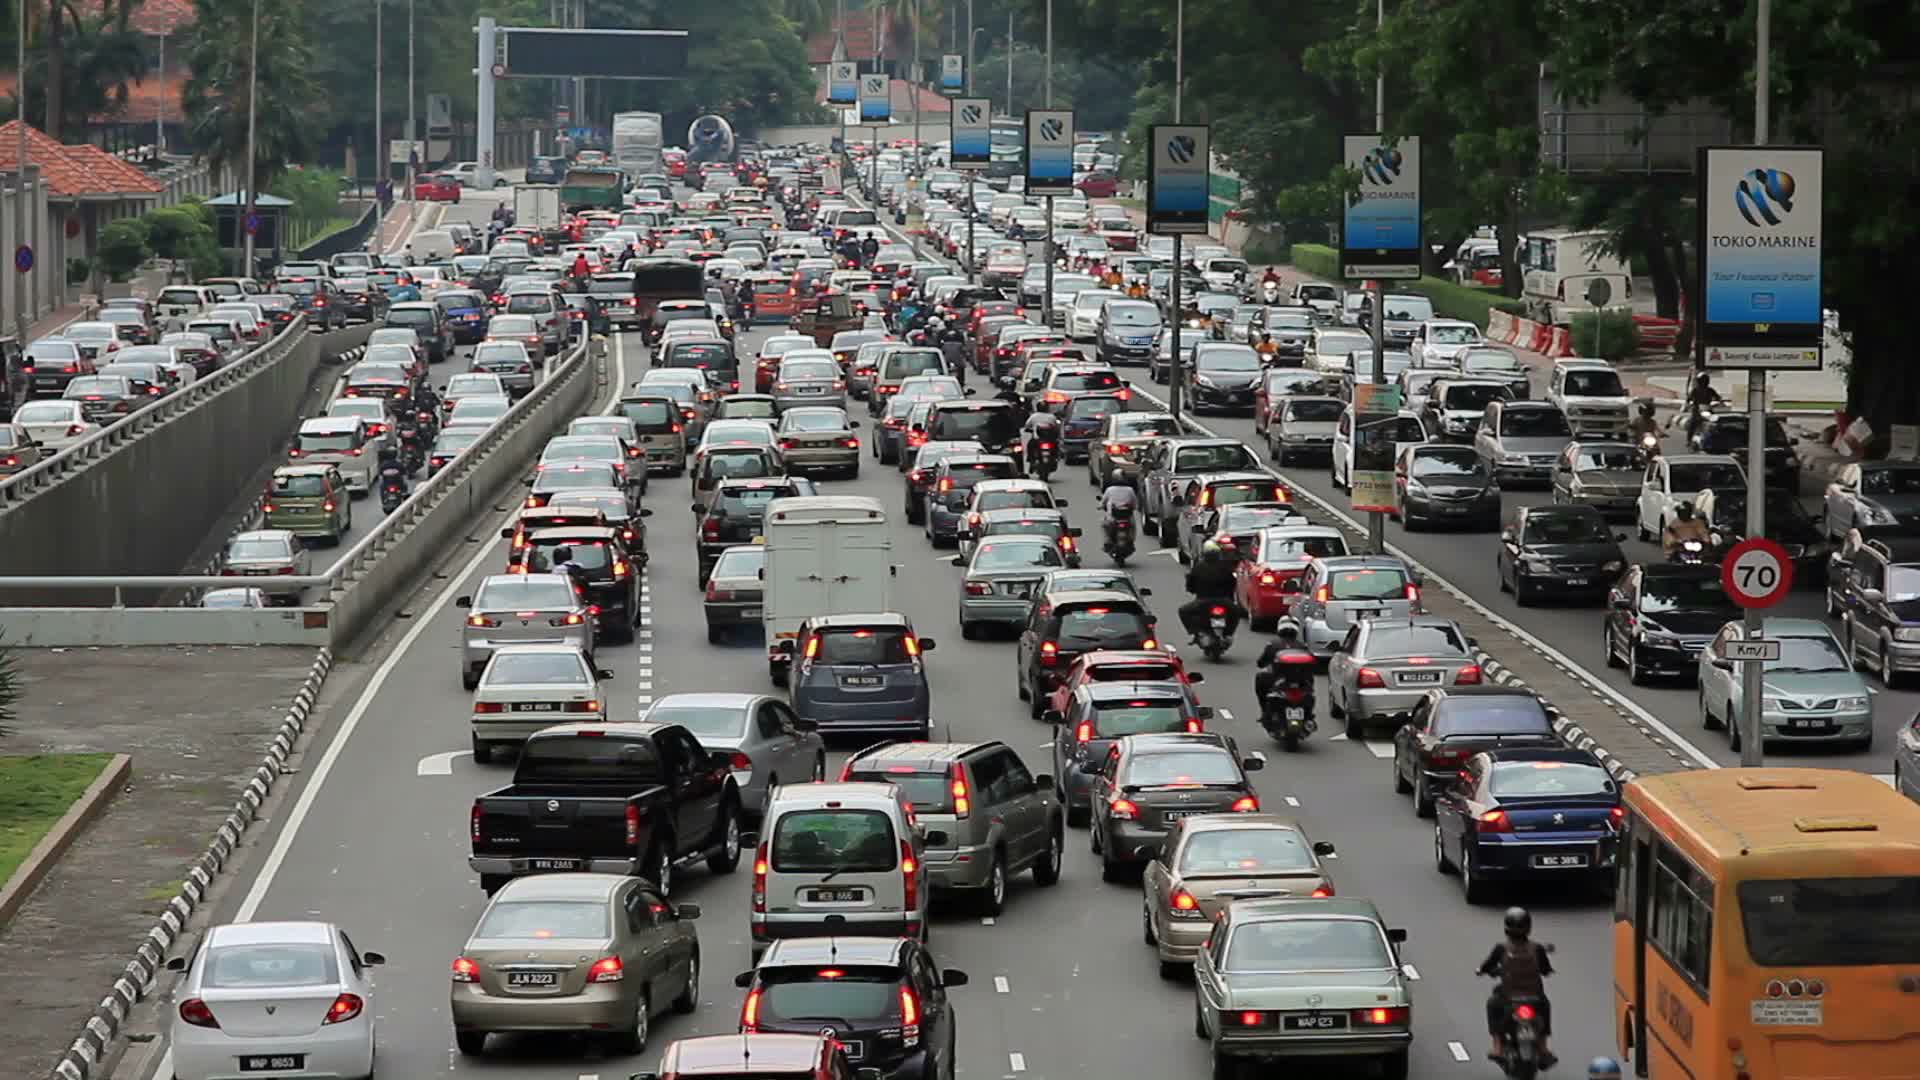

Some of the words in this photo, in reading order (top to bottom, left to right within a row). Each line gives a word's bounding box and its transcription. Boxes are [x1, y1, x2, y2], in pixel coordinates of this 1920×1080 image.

[1712, 236, 1756, 248] TOKIO
[1758, 236, 1816, 248] MARINE
[1737, 566, 1776, 588] 70
[1737, 645, 1768, 657] Km/j
